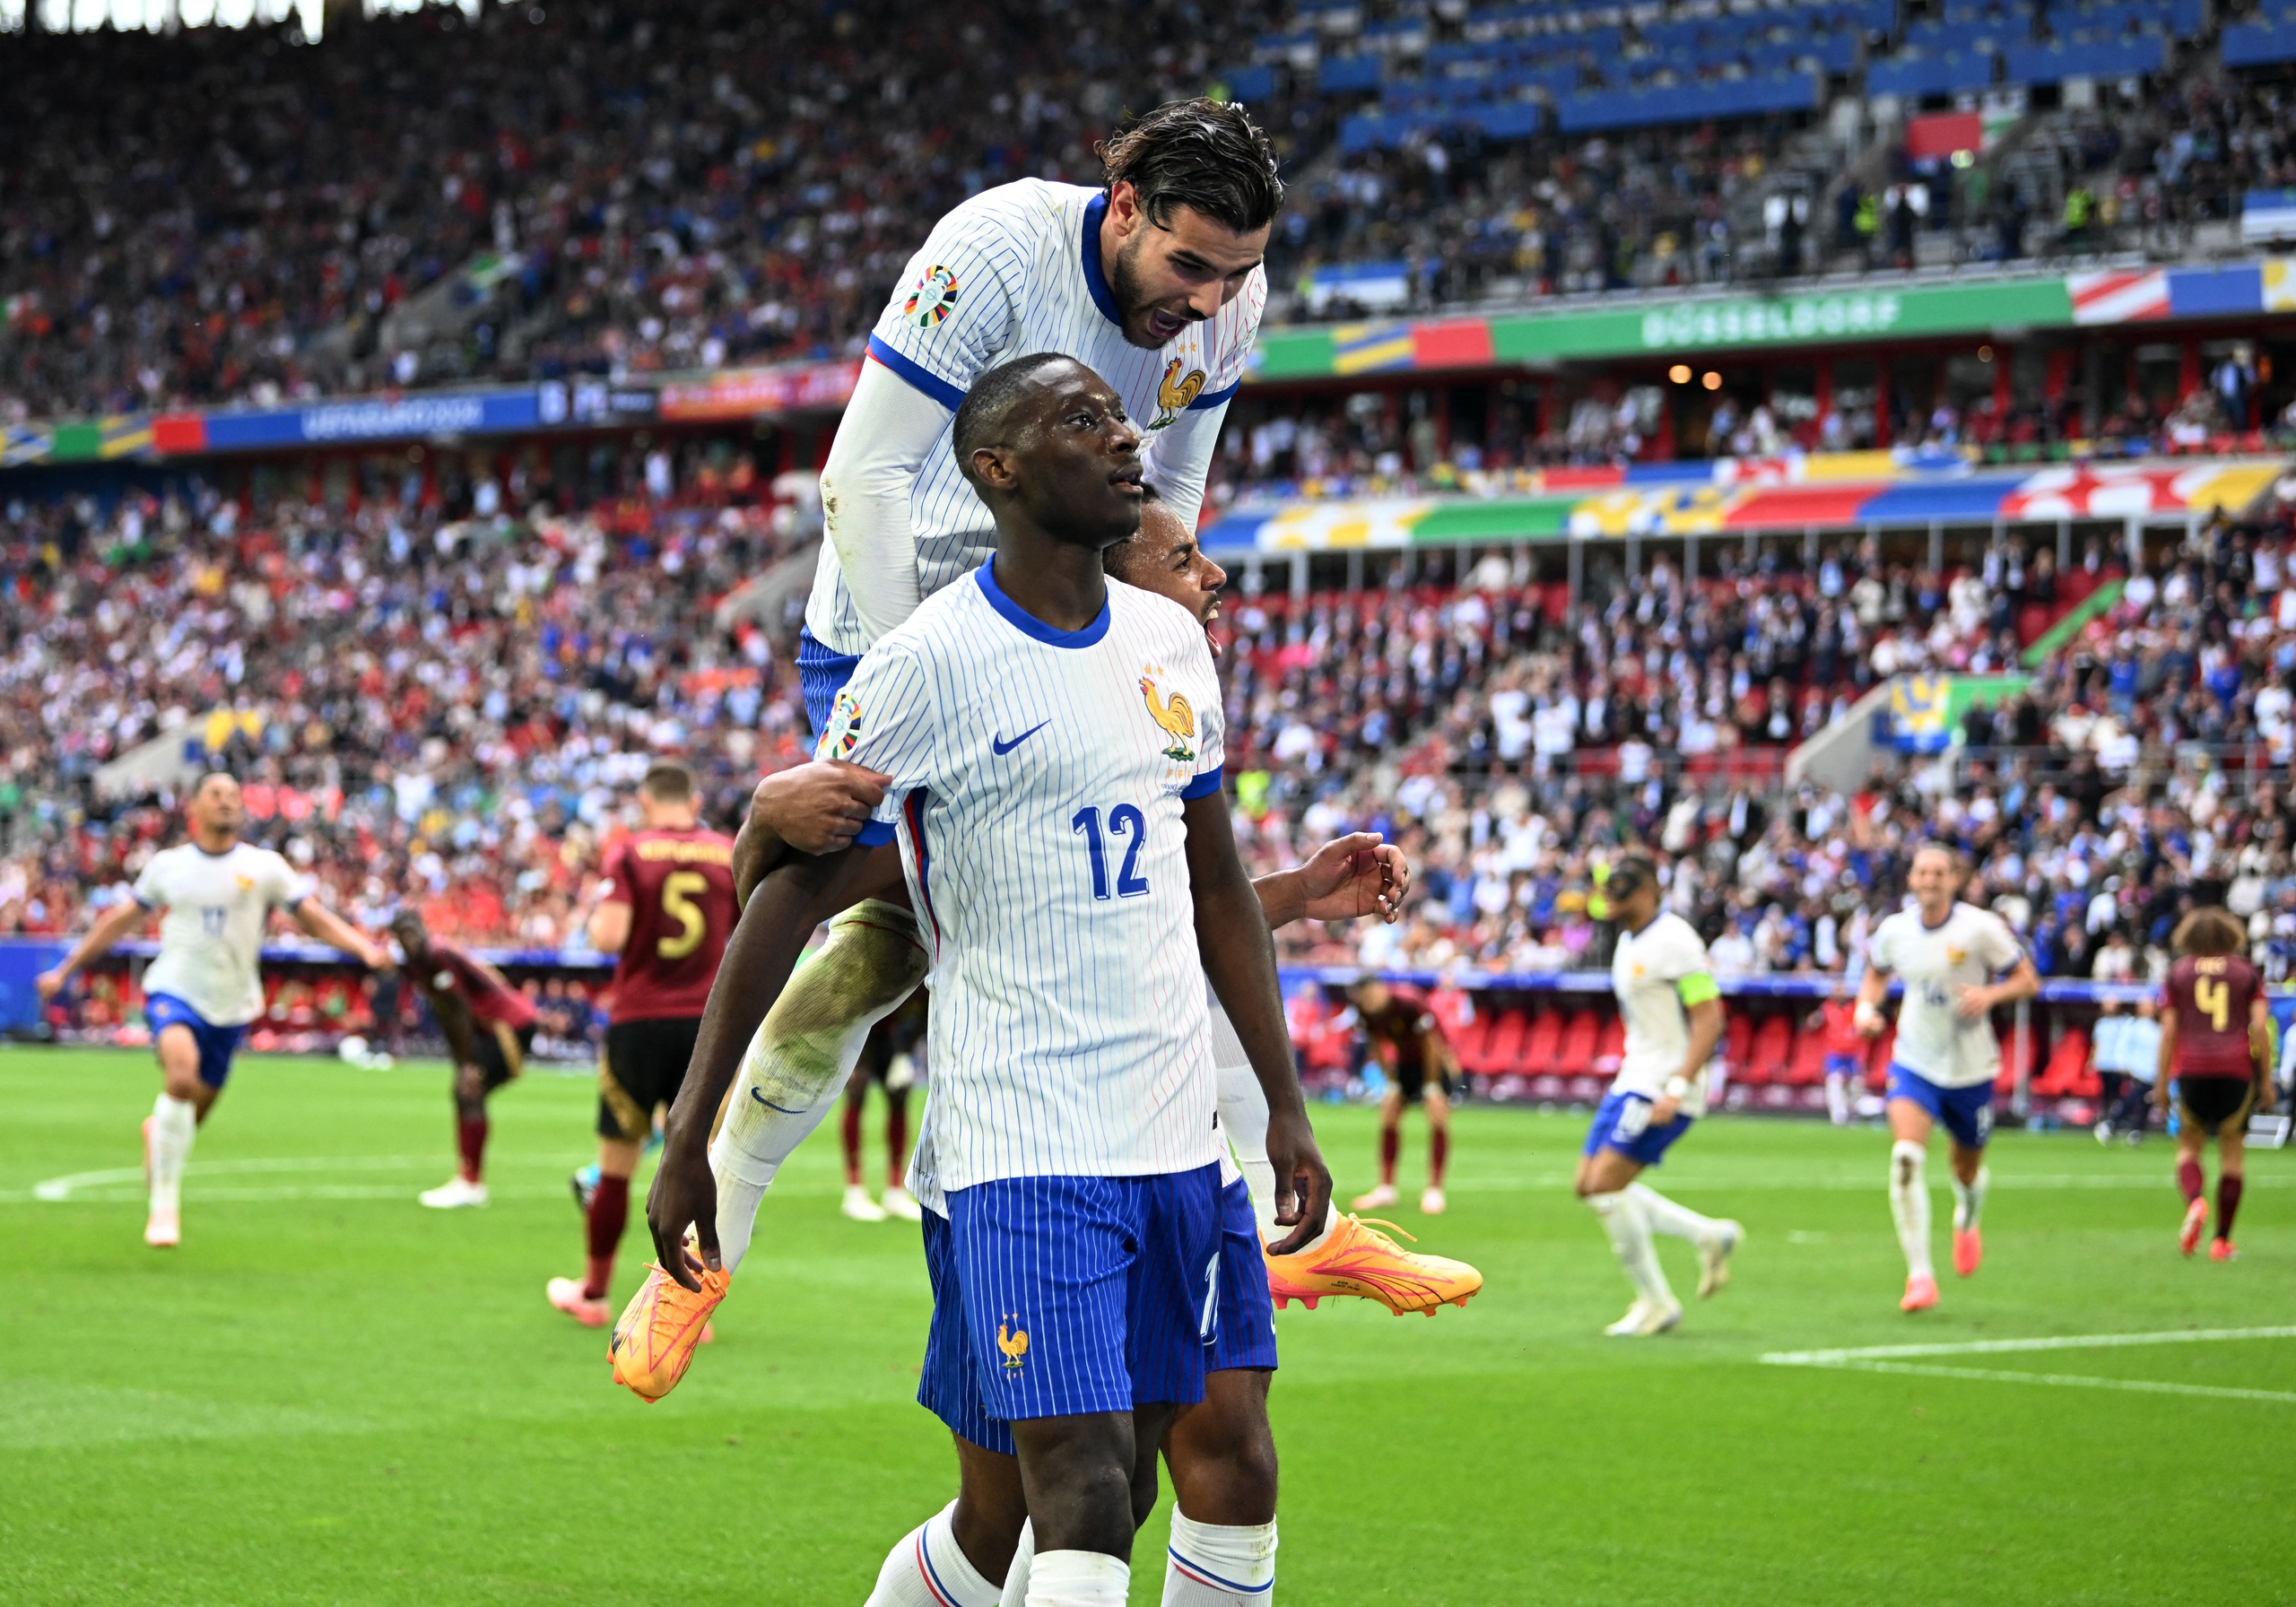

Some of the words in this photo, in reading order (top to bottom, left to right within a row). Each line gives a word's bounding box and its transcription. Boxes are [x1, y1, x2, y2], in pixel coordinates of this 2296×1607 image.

[1072, 804, 1150, 900] 12
[657, 871, 709, 959] 5
[2195, 976, 2230, 1032] 4
